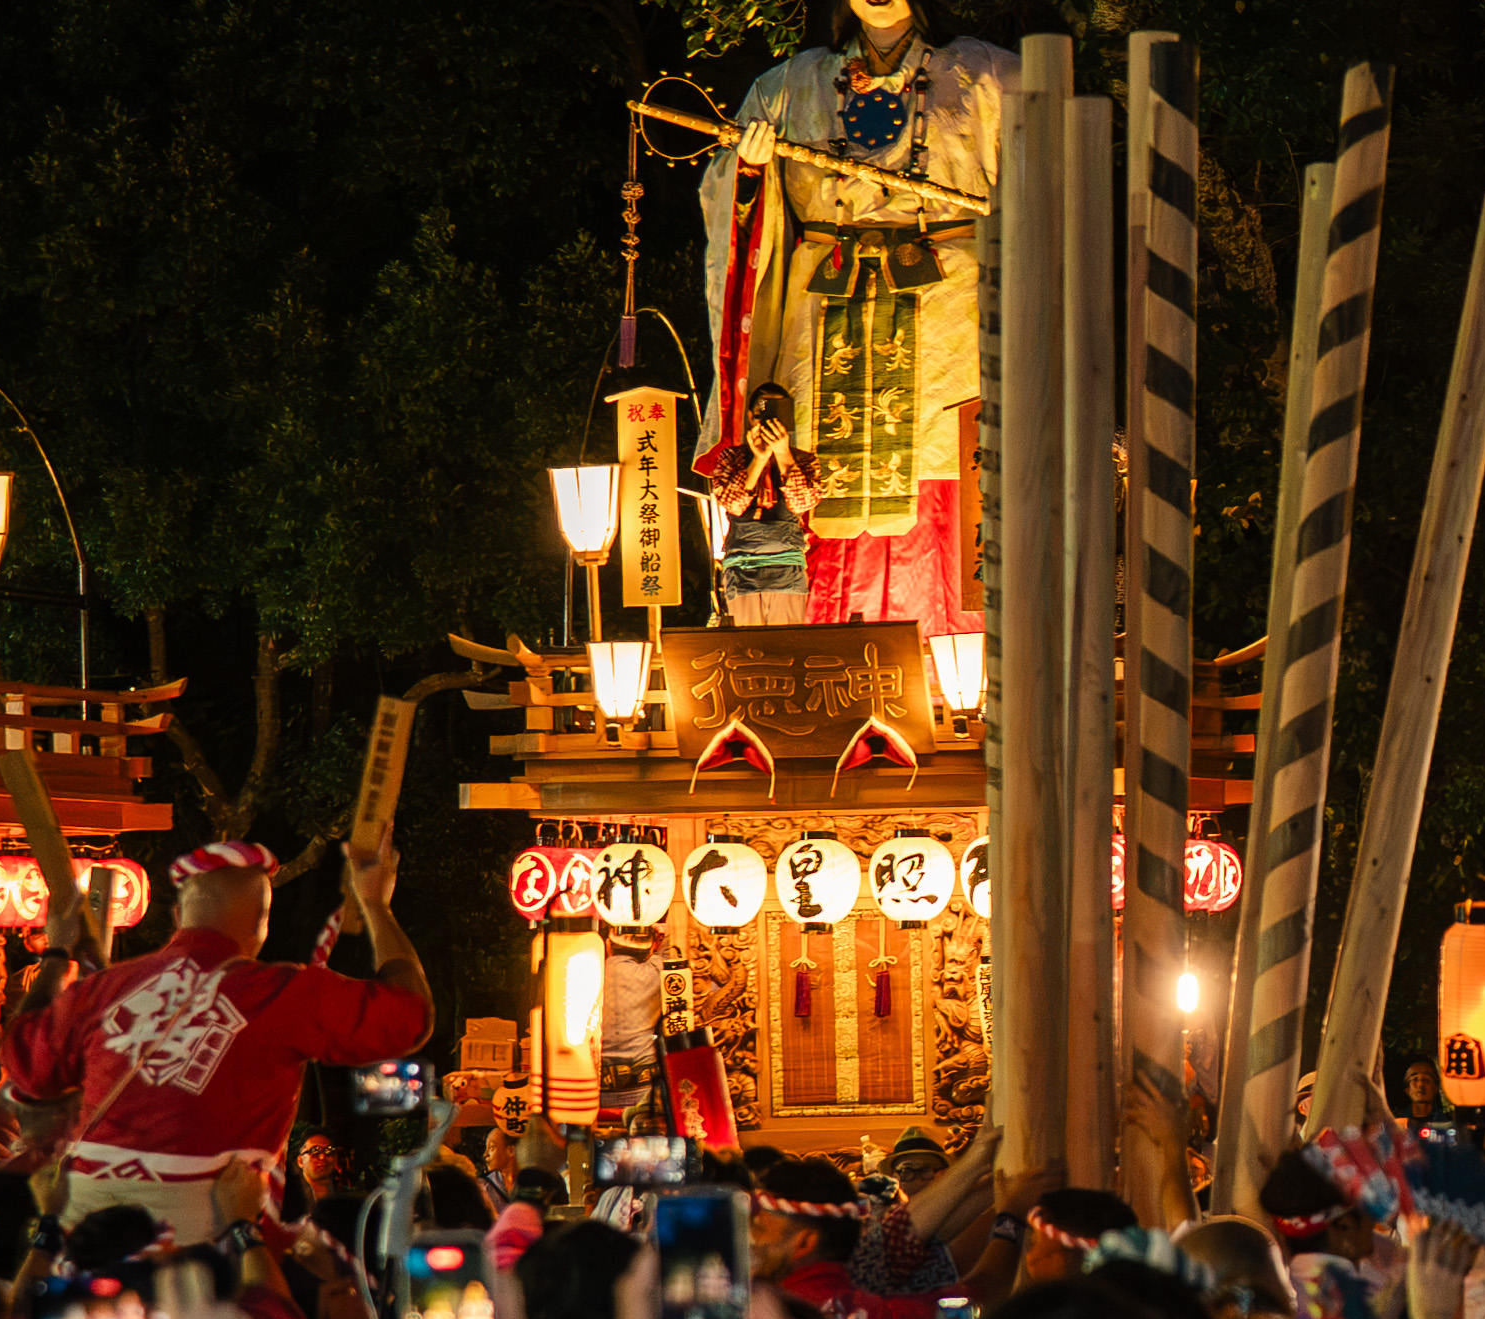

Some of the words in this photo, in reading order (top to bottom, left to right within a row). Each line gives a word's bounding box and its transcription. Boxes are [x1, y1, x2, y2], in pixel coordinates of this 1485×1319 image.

[636, 430, 662, 596] 式年大祭御船祭
